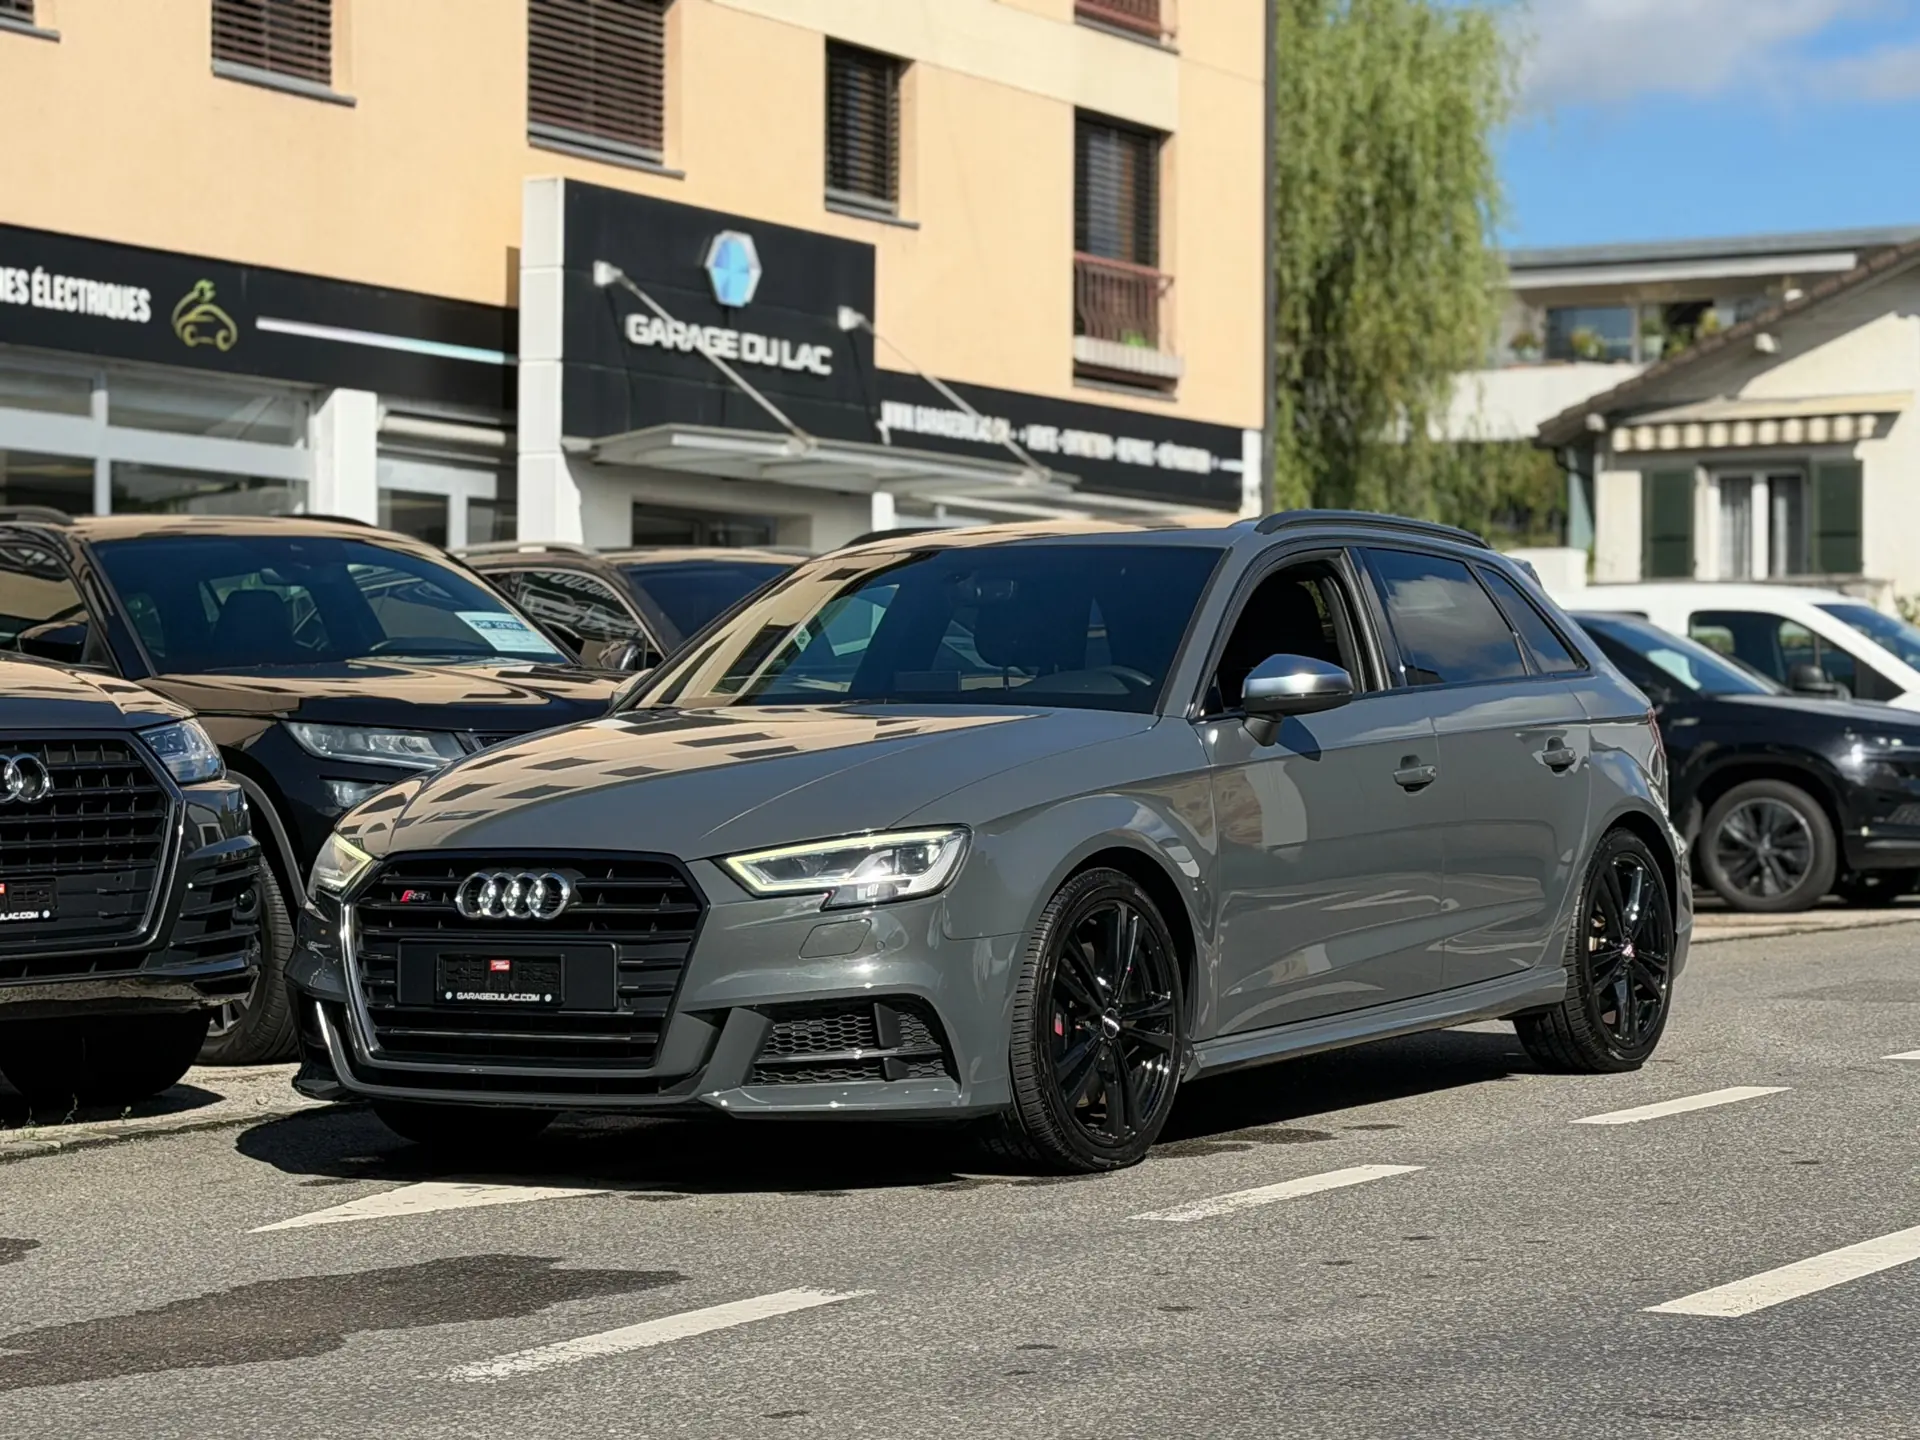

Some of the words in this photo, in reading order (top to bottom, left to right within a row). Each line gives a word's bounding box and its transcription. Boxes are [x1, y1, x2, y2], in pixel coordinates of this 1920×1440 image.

[0, 266, 30, 305] ES
[31, 265, 151, 323] ÉLECTRIQUES
[625, 313, 739, 360] GARAGE
[740, 332, 779, 366] DU
[780, 339, 833, 376] LAC
[456, 991, 540, 1002] GARAGEDULAC.COM
